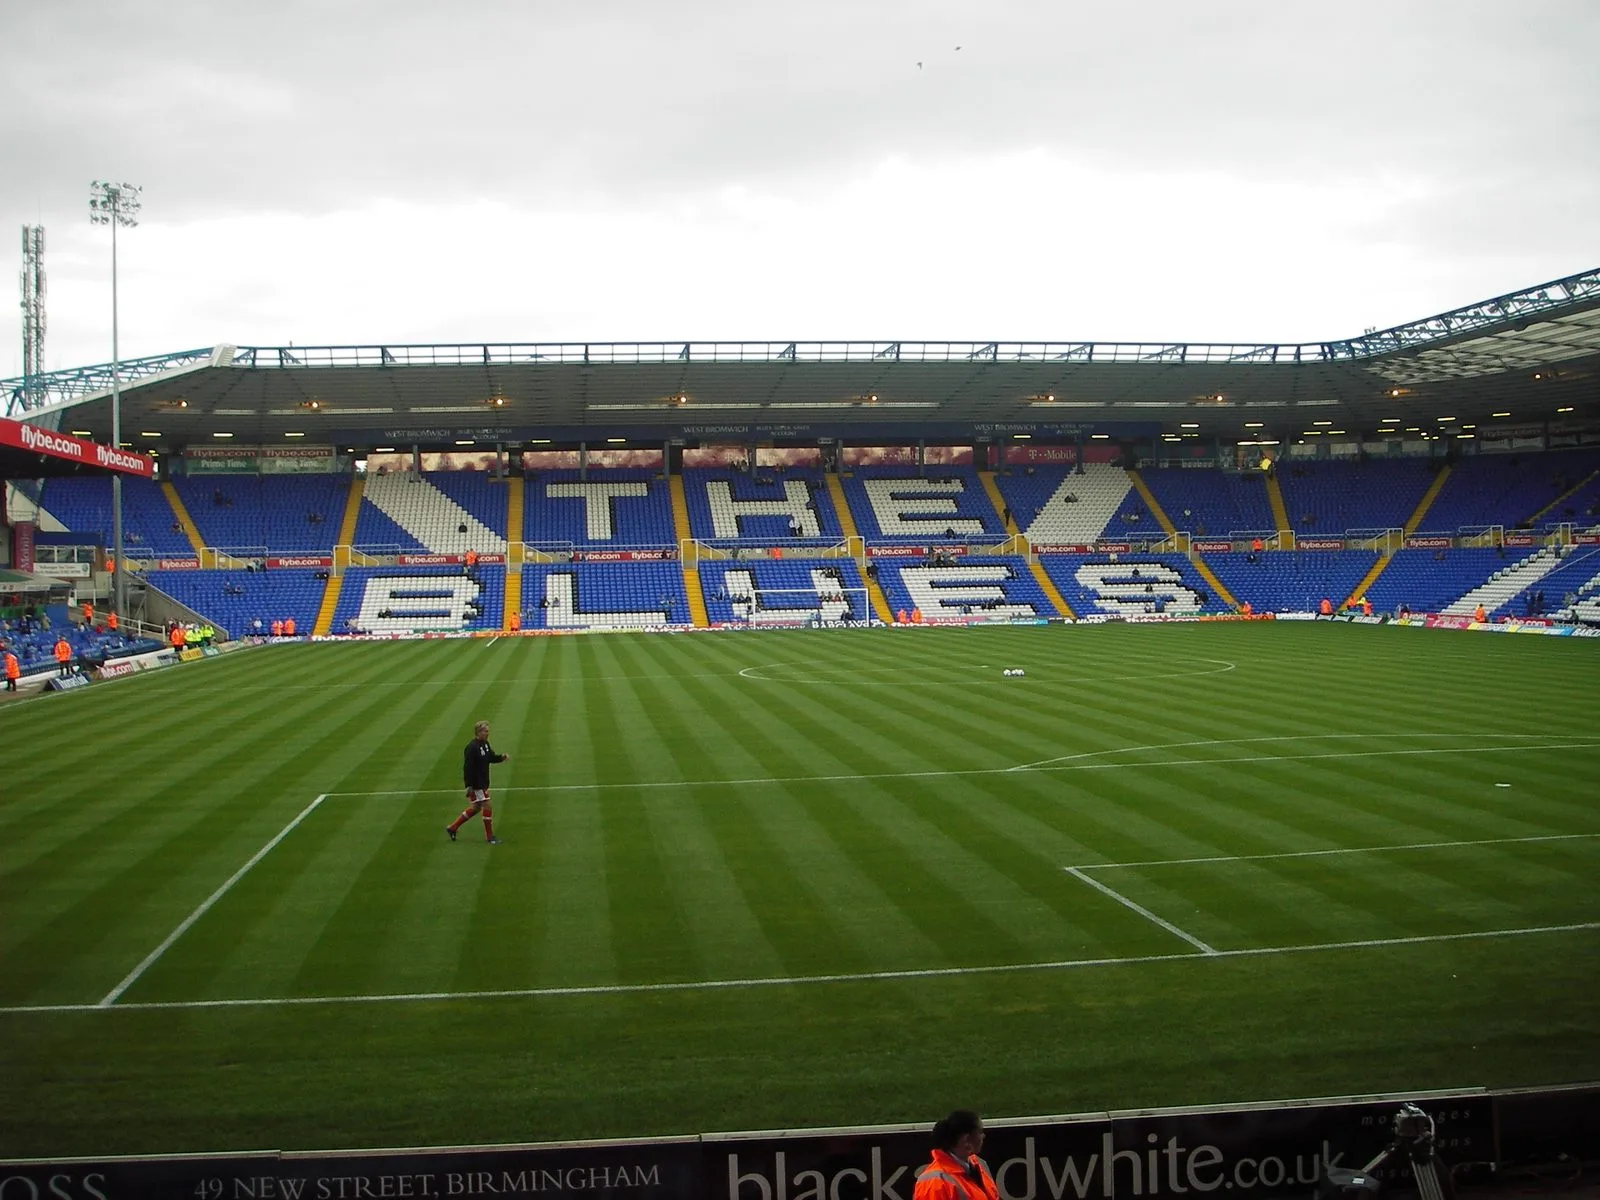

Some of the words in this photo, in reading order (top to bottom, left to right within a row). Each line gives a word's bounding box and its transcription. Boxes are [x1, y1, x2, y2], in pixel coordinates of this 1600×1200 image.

[21, 424, 82, 456] flybe.com
[192, 449, 256, 457] flybe.com
[97, 445, 144, 471] flybe.com
[201, 460, 226, 468] Prime
[226, 460, 247, 468] Time
[1198, 543, 1229, 551] flybe.com
[1300, 540, 1340, 549] flybe.com
[1410, 538, 1447, 547] flybe.com
[872, 547, 912, 555] flybe.com
[1037, 545, 1076, 554] flybe.com
[405, 556, 446, 564] flybe.com
[457, 555, 499, 563] fl.com
[579, 552, 621, 561] fybe.com
[161, 560, 198, 569] flybe.com
[278, 558, 321, 567] flybe.com
[1361, 1108, 1472, 1126] moges
[728, 1132, 1344, 1200] blackdwhite.co.uk
[194, 1178, 224, 1200] 49
[233, 1176, 307, 1200] NEW
[317, 1173, 440, 1200] STREET,
[446, 1164, 661, 1195] BIRMINGHAM
